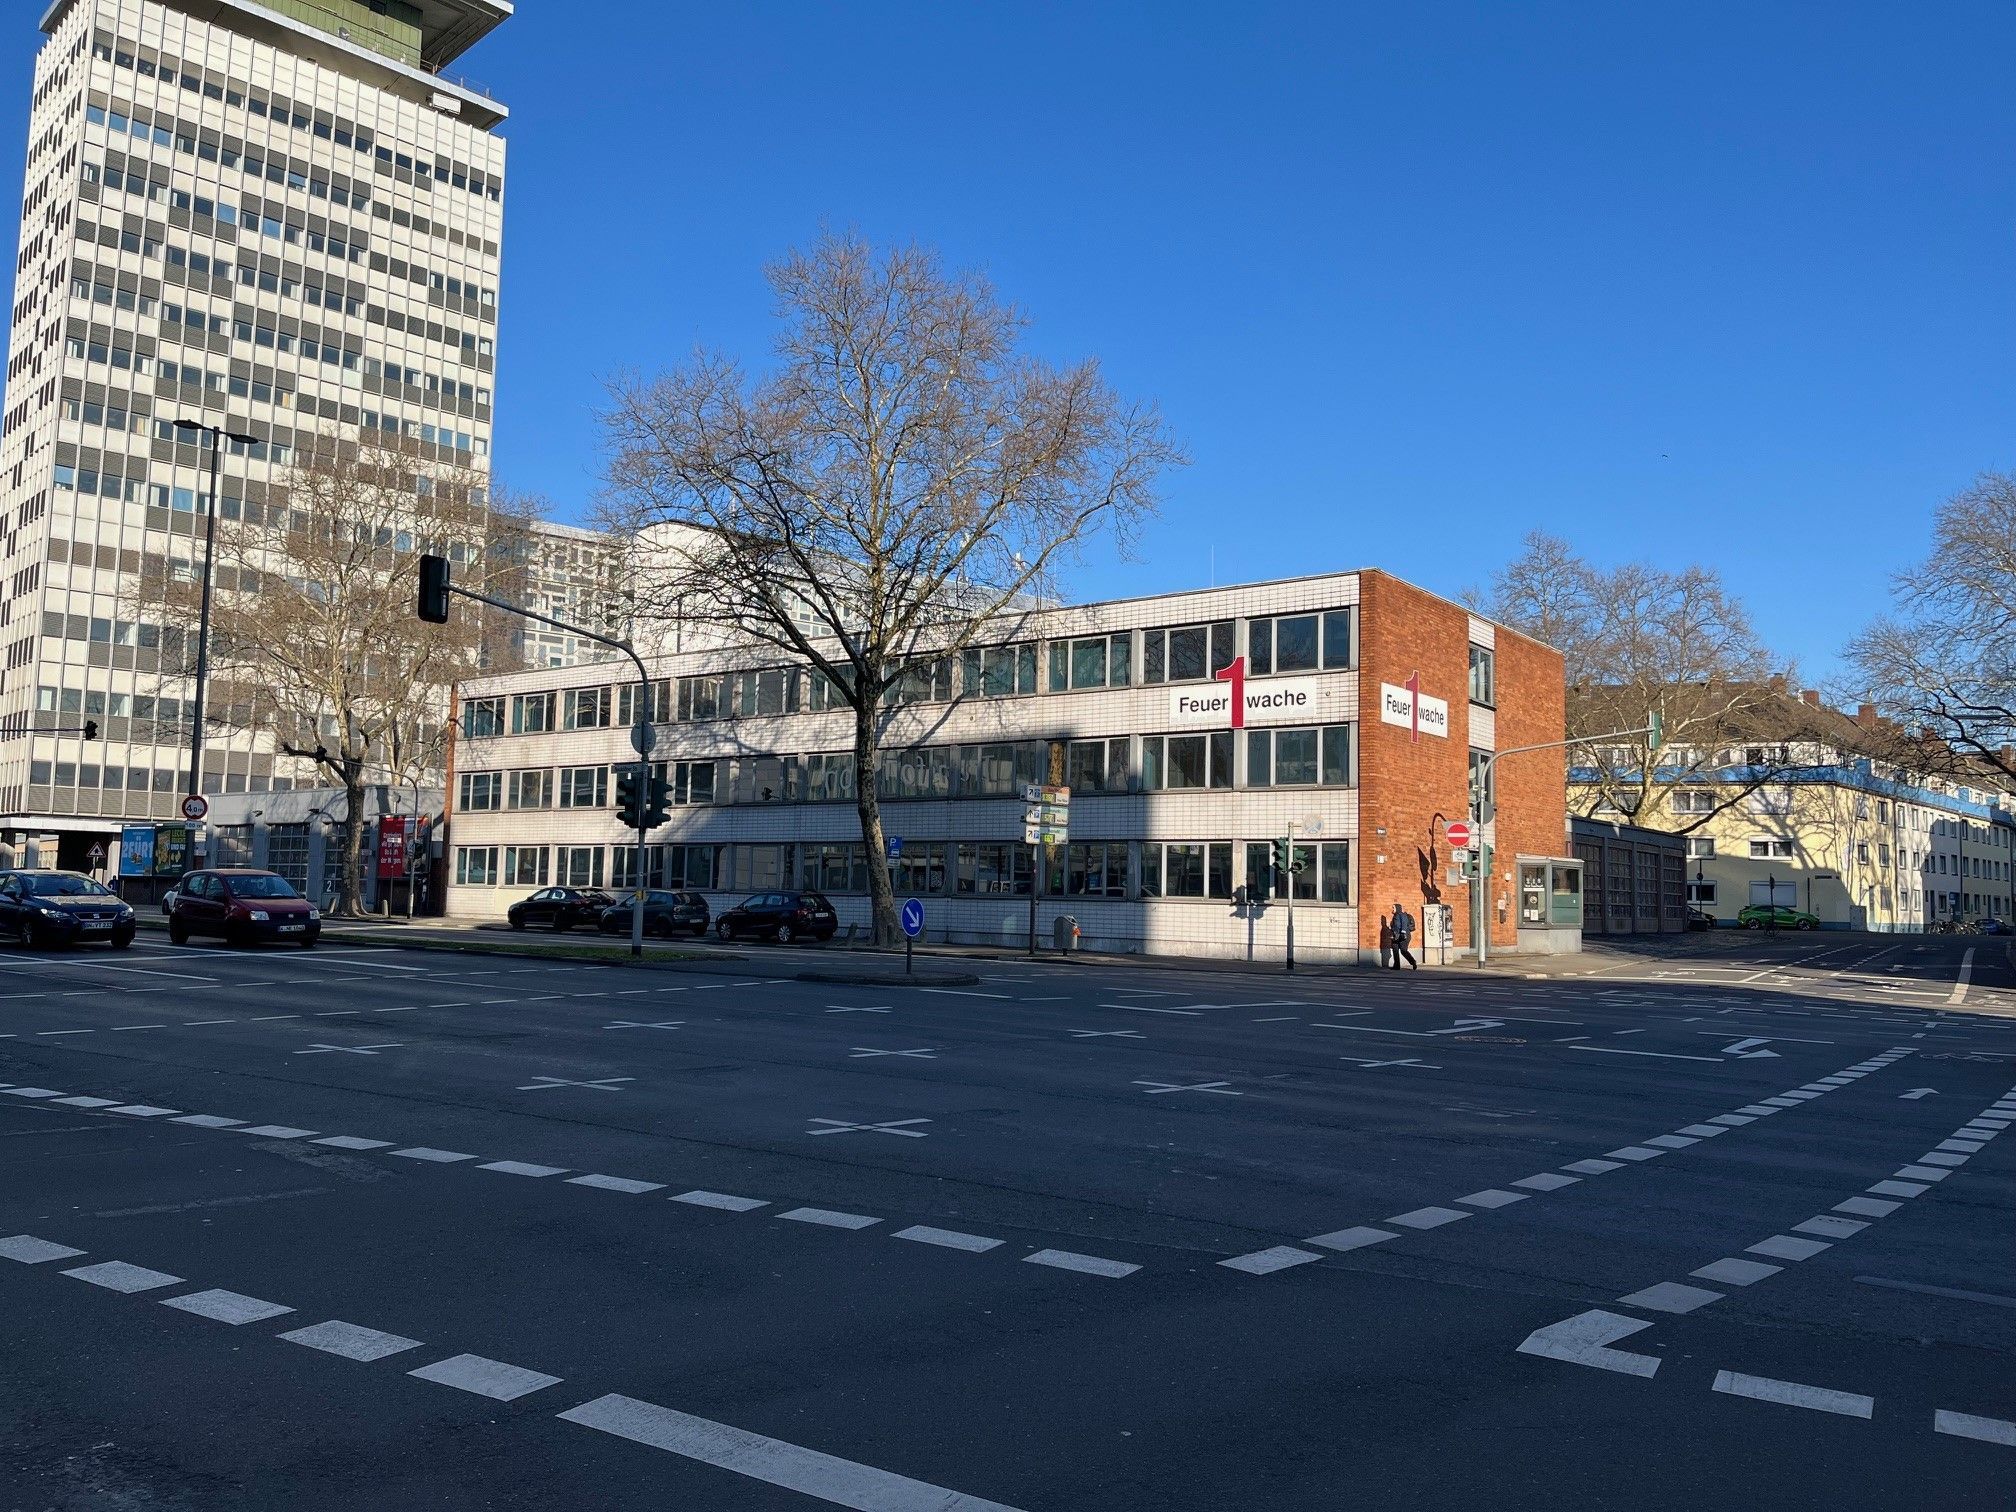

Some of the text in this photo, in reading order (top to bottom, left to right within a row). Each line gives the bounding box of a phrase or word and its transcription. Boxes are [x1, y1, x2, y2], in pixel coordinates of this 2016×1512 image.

[1179, 656, 1307, 728] Feuer 1 wache
[1386, 669, 1444, 744] Feuer 1 wache
[890, 837, 896, 846] P
[326, 880, 332, 892] 2
